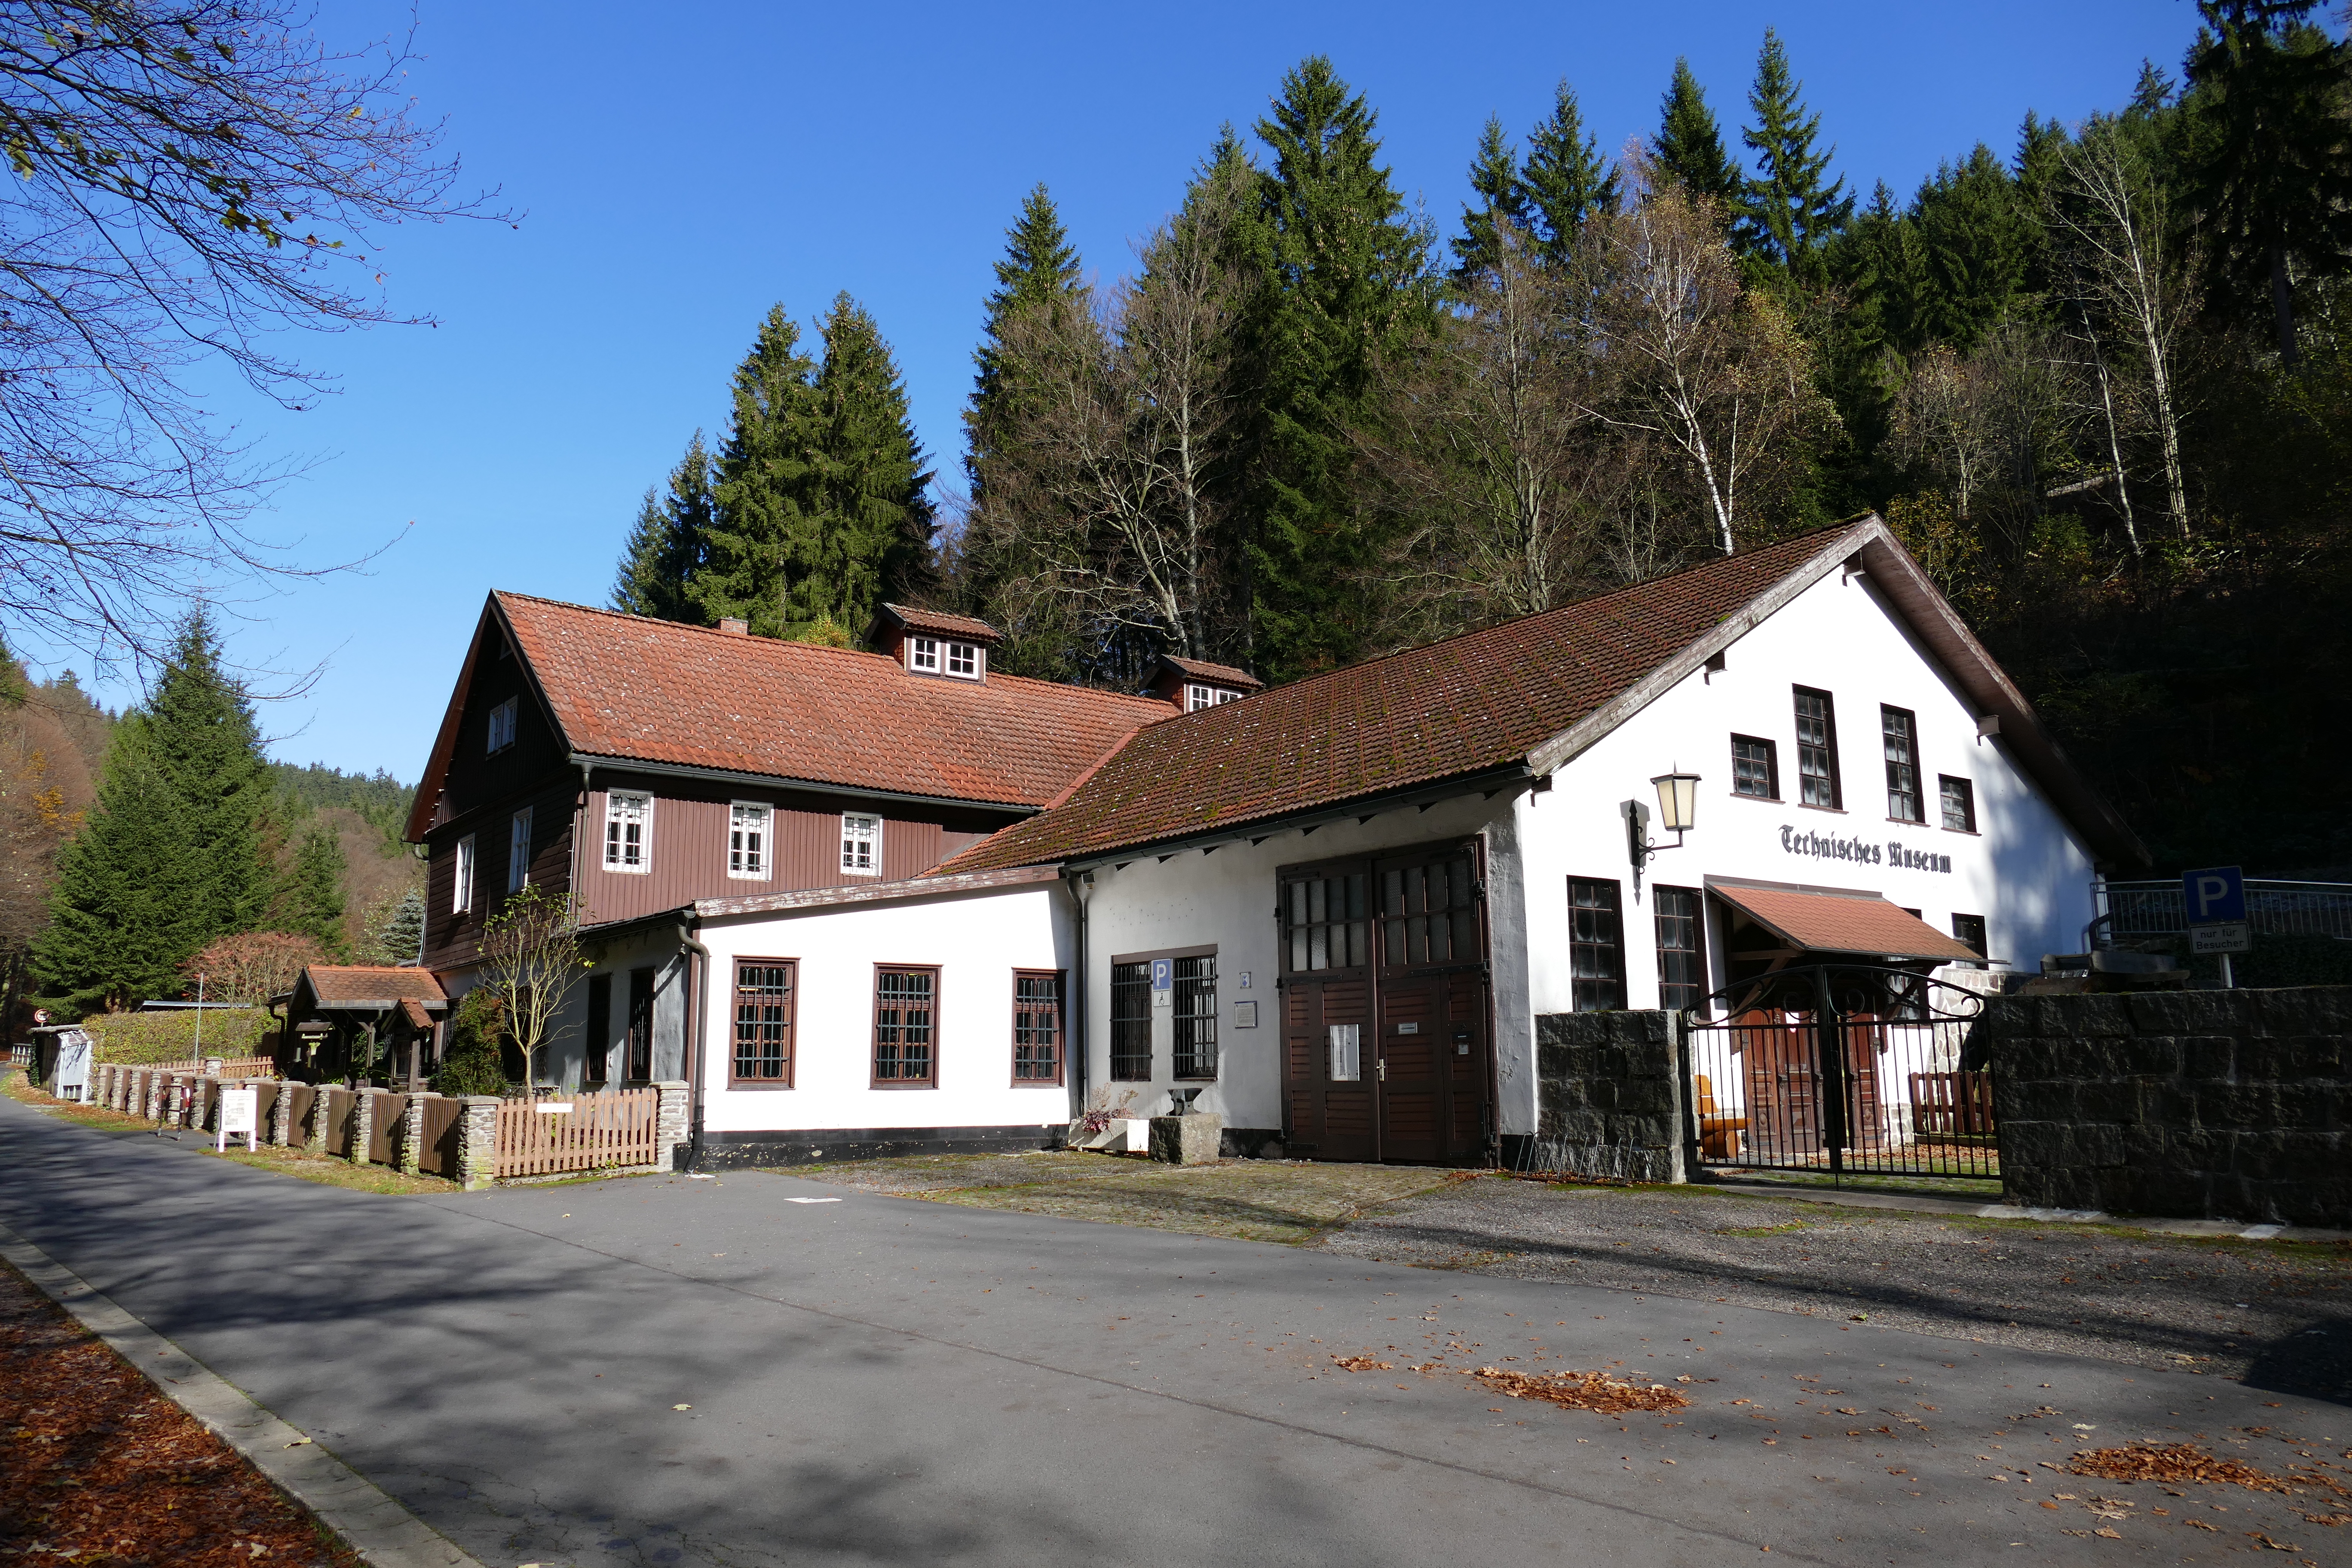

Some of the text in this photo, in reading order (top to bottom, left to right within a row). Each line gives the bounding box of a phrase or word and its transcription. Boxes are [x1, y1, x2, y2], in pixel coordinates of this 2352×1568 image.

[1779, 824, 1951, 874] Technisches Museum
[2197, 876, 2228, 916] P
[2222, 928, 2237, 937] für
[2196, 940, 2244, 949] Besucher
[1157, 964, 1167, 986] P
